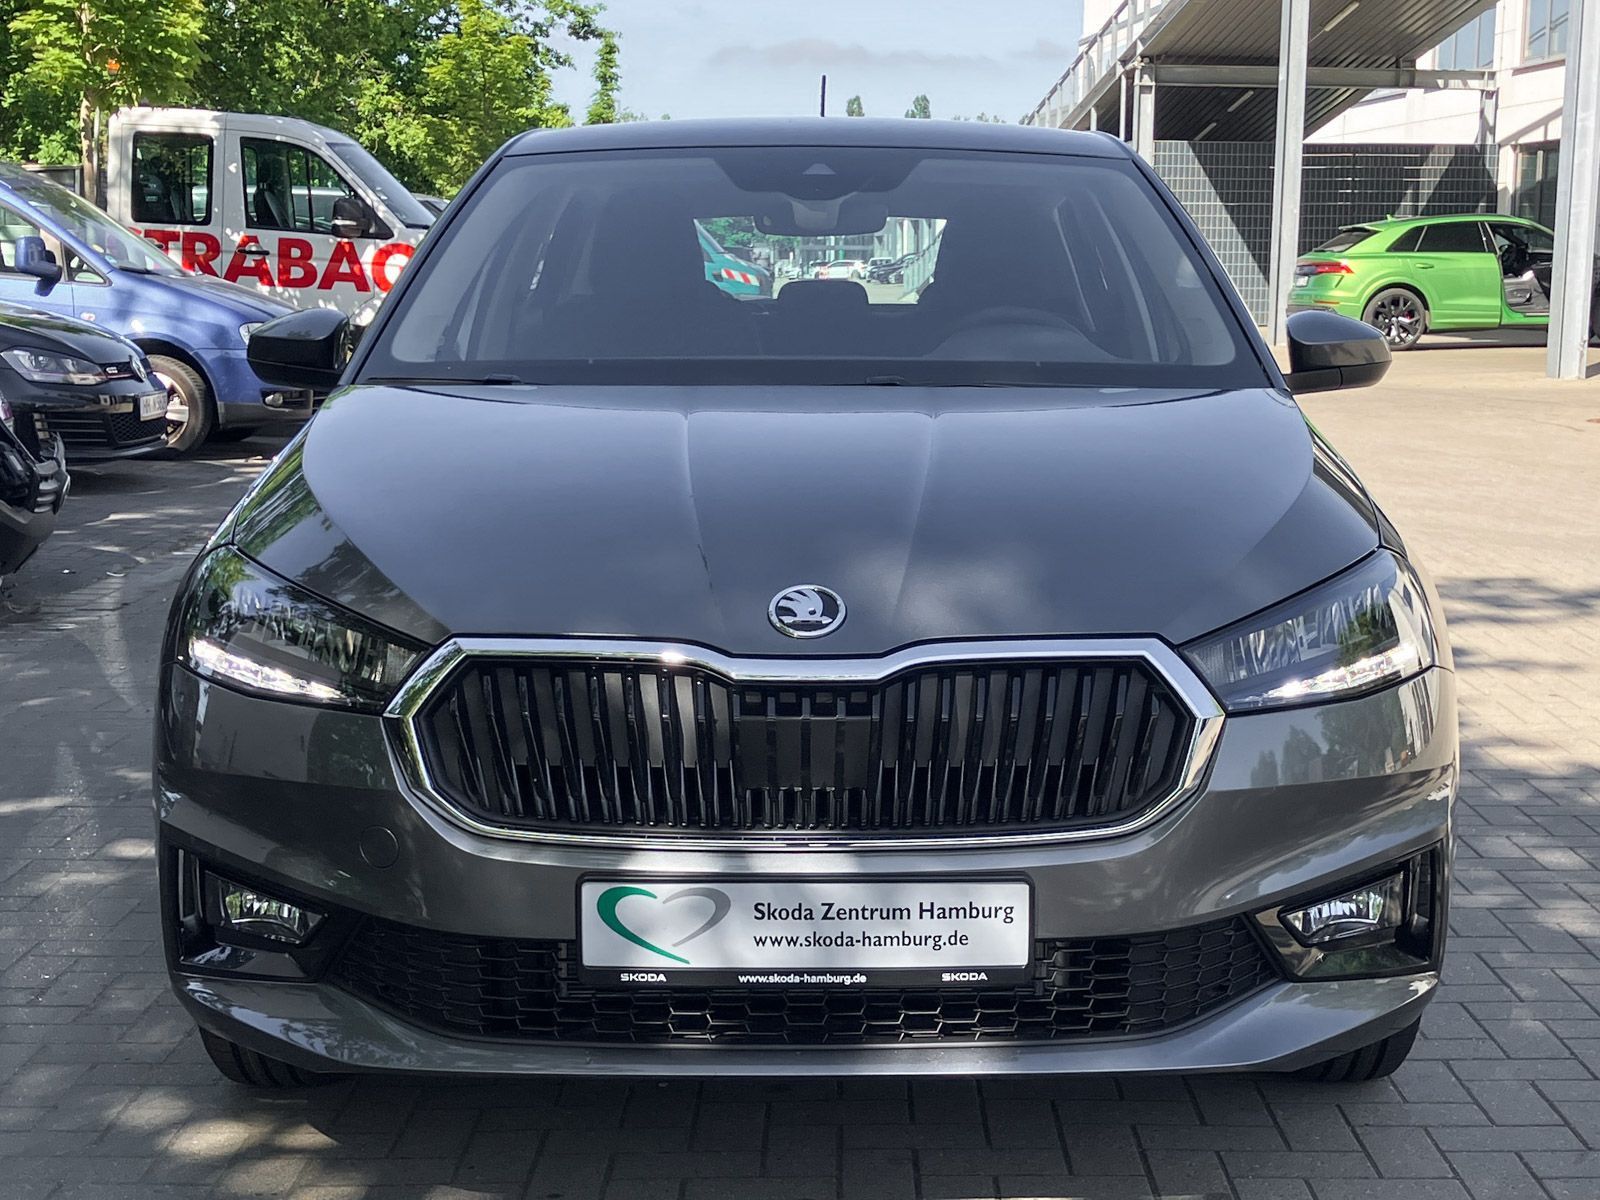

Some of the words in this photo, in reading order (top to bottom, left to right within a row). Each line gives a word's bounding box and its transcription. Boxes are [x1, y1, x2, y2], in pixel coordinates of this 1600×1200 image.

[128, 226, 416, 294] TRABAG
[753, 902, 815, 921] Skoda
[820, 902, 911, 921] Zentrum
[919, 901, 1015, 924] Hamburg
[753, 930, 969, 951] www.skoda-hamburg.de
[620, 973, 667, 983] SKODA
[738, 972, 867, 985] www.skoda-hamburg.de
[941, 972, 988, 982] SKODA
